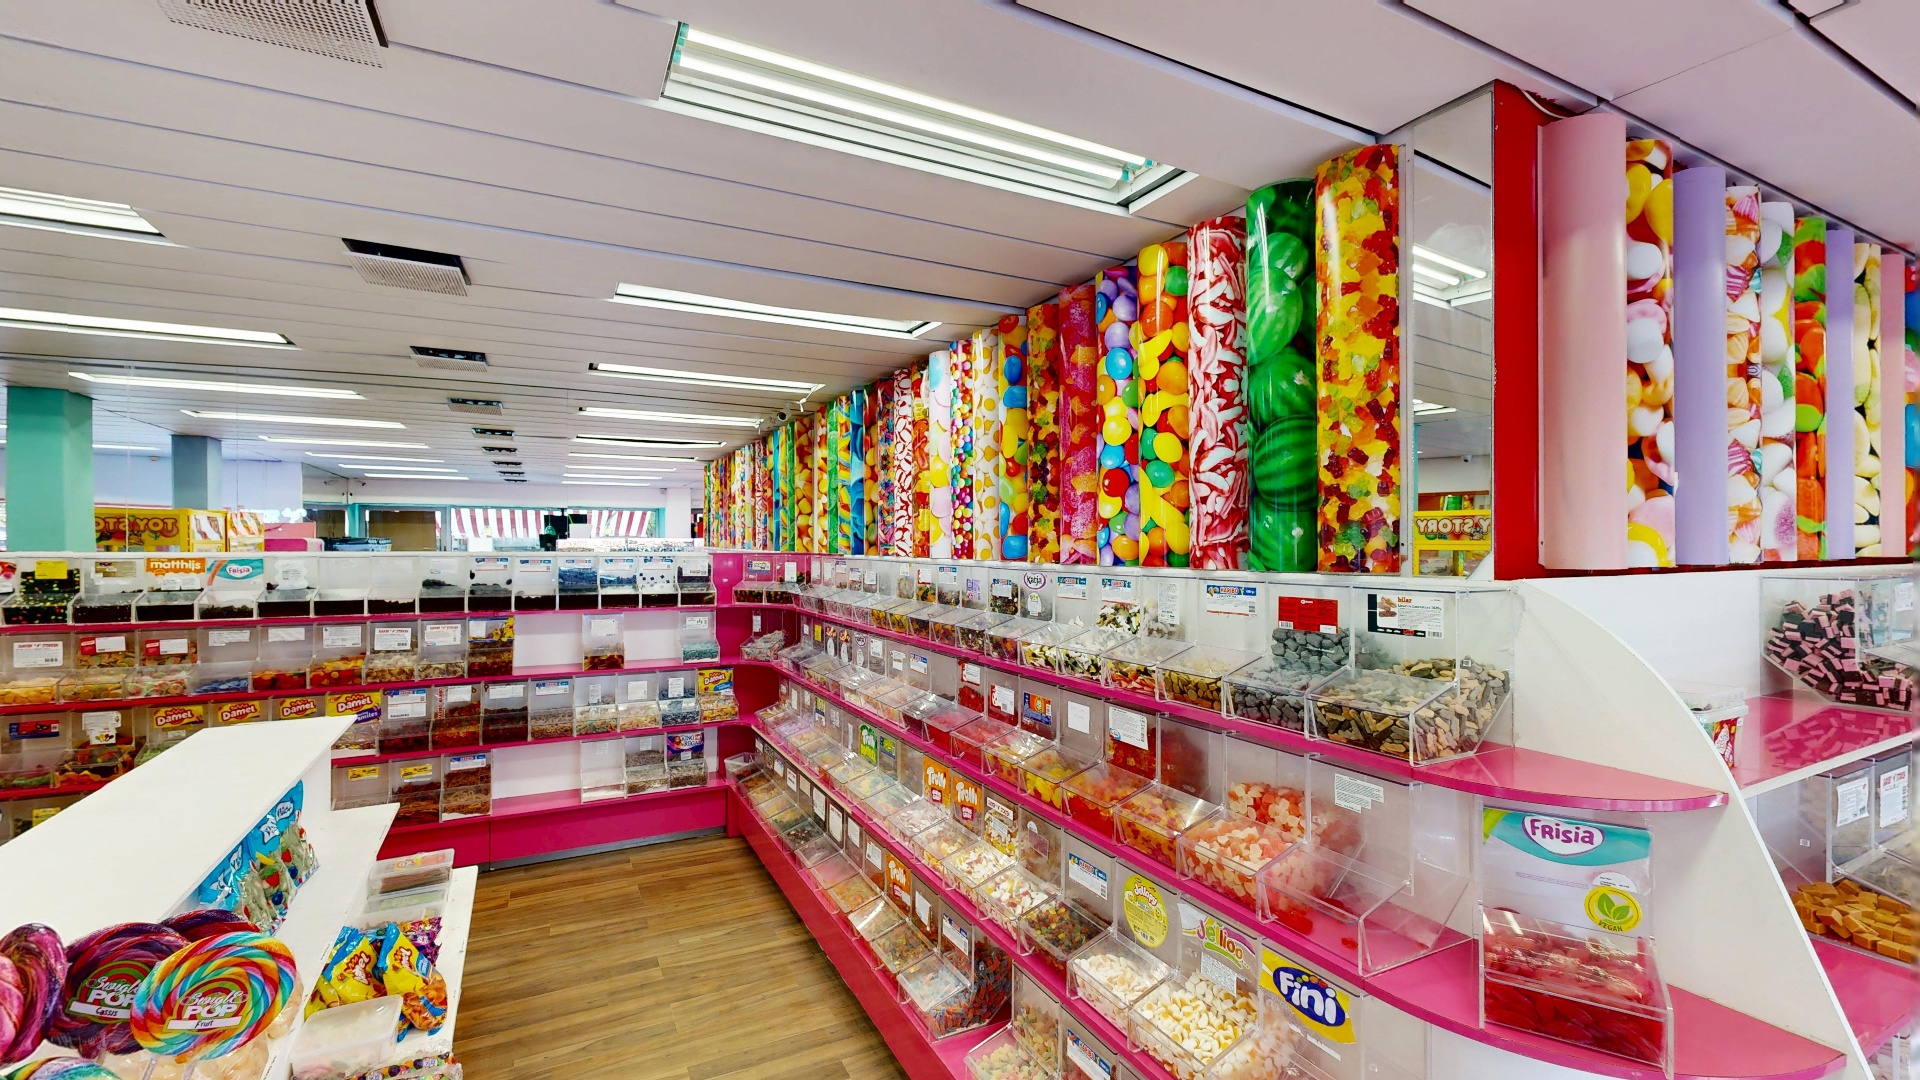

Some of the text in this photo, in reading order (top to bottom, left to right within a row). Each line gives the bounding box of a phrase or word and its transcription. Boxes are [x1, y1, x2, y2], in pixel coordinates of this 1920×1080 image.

[150, 560, 201, 571] matthijs
[1027, 575, 1042, 586] Katja
[1598, 920, 1623, 932] VEGAN
[1280, 970, 1337, 1024] Fini
[183, 1004, 238, 1019] POP
